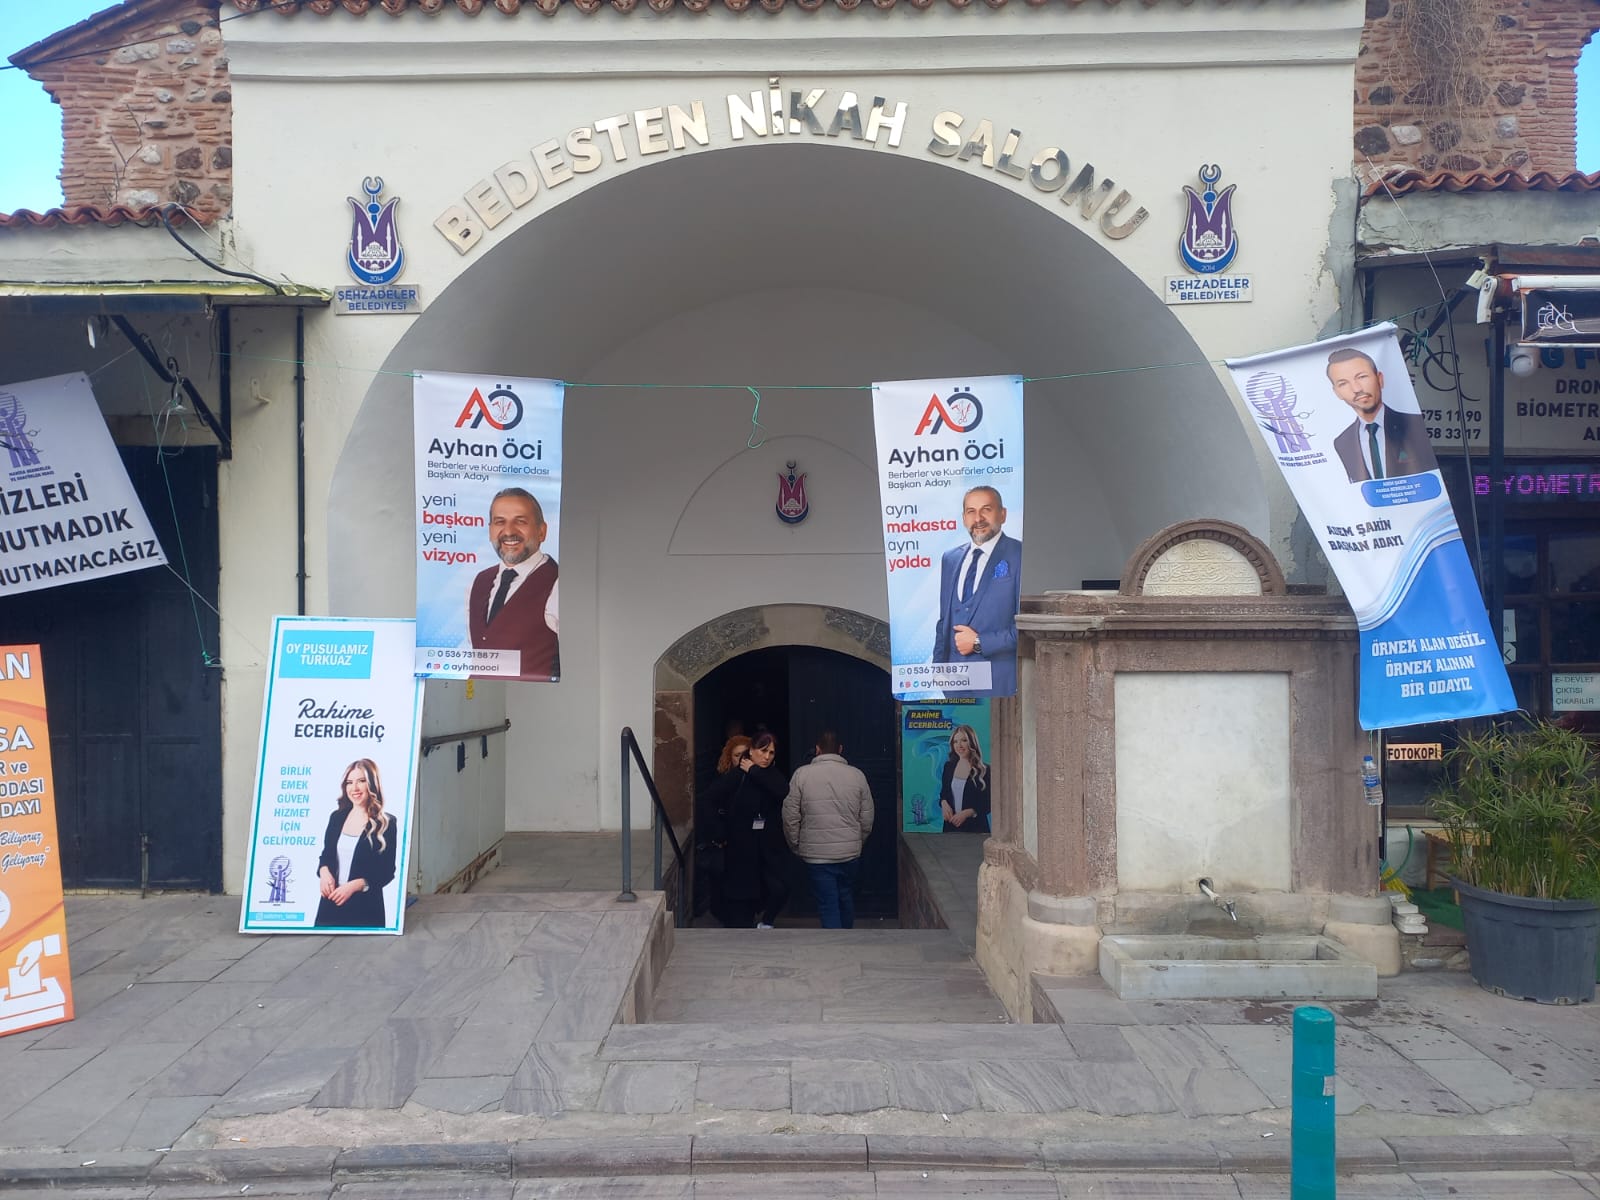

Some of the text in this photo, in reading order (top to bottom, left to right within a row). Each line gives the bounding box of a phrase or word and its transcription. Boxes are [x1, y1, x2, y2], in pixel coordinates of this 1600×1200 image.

[433, 76, 1150, 256] BEDESTEN NİKAH SALONU
[1170, 278, 1249, 292] ŞEHZADELER
[338, 289, 416, 302] ŞEHZADELER
[1180, 290, 1239, 300] BELEDİYESİ
[348, 301, 407, 311] BELEDİYESİ
[1575, 348, 1600, 369] F
[1516, 398, 1600, 418] BİOMETR
[1446, 410, 1461, 421] 11
[1466, 411, 1481, 421] 90
[1445, 428, 1461, 439] 33
[1467, 428, 1481, 439] 17
[428, 438, 542, 460] Ayhan Öci
[888, 438, 1004, 468] Ayhan Öci
[427, 460, 467, 470] Berberler
[481, 464, 522, 474] Kuaförler
[523, 466, 550, 475] Odası
[888, 470, 929, 479] Berberler
[943, 467, 985, 476] Kuaförler
[986, 466, 1013, 474] Odası
[427, 470, 490, 482] Başkan Adayı
[888, 479, 951, 490] Başkan Adayı
[0, 472, 88, 516] İZLERİ
[422, 493, 457, 509] yeni
[885, 504, 918, 518] aynı
[423, 510, 484, 528] başkan
[887, 519, 957, 533] makasta
[1356, 517, 1391, 537] ŞAHİN
[422, 530, 457, 546] yeni
[1373, 535, 1404, 549] ADAYI
[888, 540, 919, 554] aynı
[422, 547, 477, 565] vizyon
[889, 555, 931, 572] yolda
[286, 643, 369, 655] OY PUSULAMIZ
[445, 650, 460, 658] 536
[1371, 639, 1417, 657] ÖRNEK
[1420, 637, 1447, 652] ALAN
[301, 654, 352, 666] TURKUAZ
[1385, 655, 1475, 677] ÖRNEK ALINAN
[451, 663, 500, 673] ayhanooci
[921, 678, 970, 688] ayhanooci
[1401, 677, 1473, 698] BİR ODAYIZ
[298, 698, 375, 719] Rahime
[911, 710, 940, 719] RAHİME
[294, 721, 385, 743] ECERBİLGİÇ
[908, 720, 953, 730] ECERBİLGİÇ
[1387, 744, 1438, 760] FOTOKOPİ
[11, 763, 28, 773] ve
[280, 765, 312, 776] BİRLİK
[281, 780, 309, 790] EMEK
[277, 792, 310, 803] GÜVEN
[280, 821, 301, 833] İÇİN
[0, 832, 41, 846] Biliyoruz
[262, 834, 317, 846] GELİYORUZ
